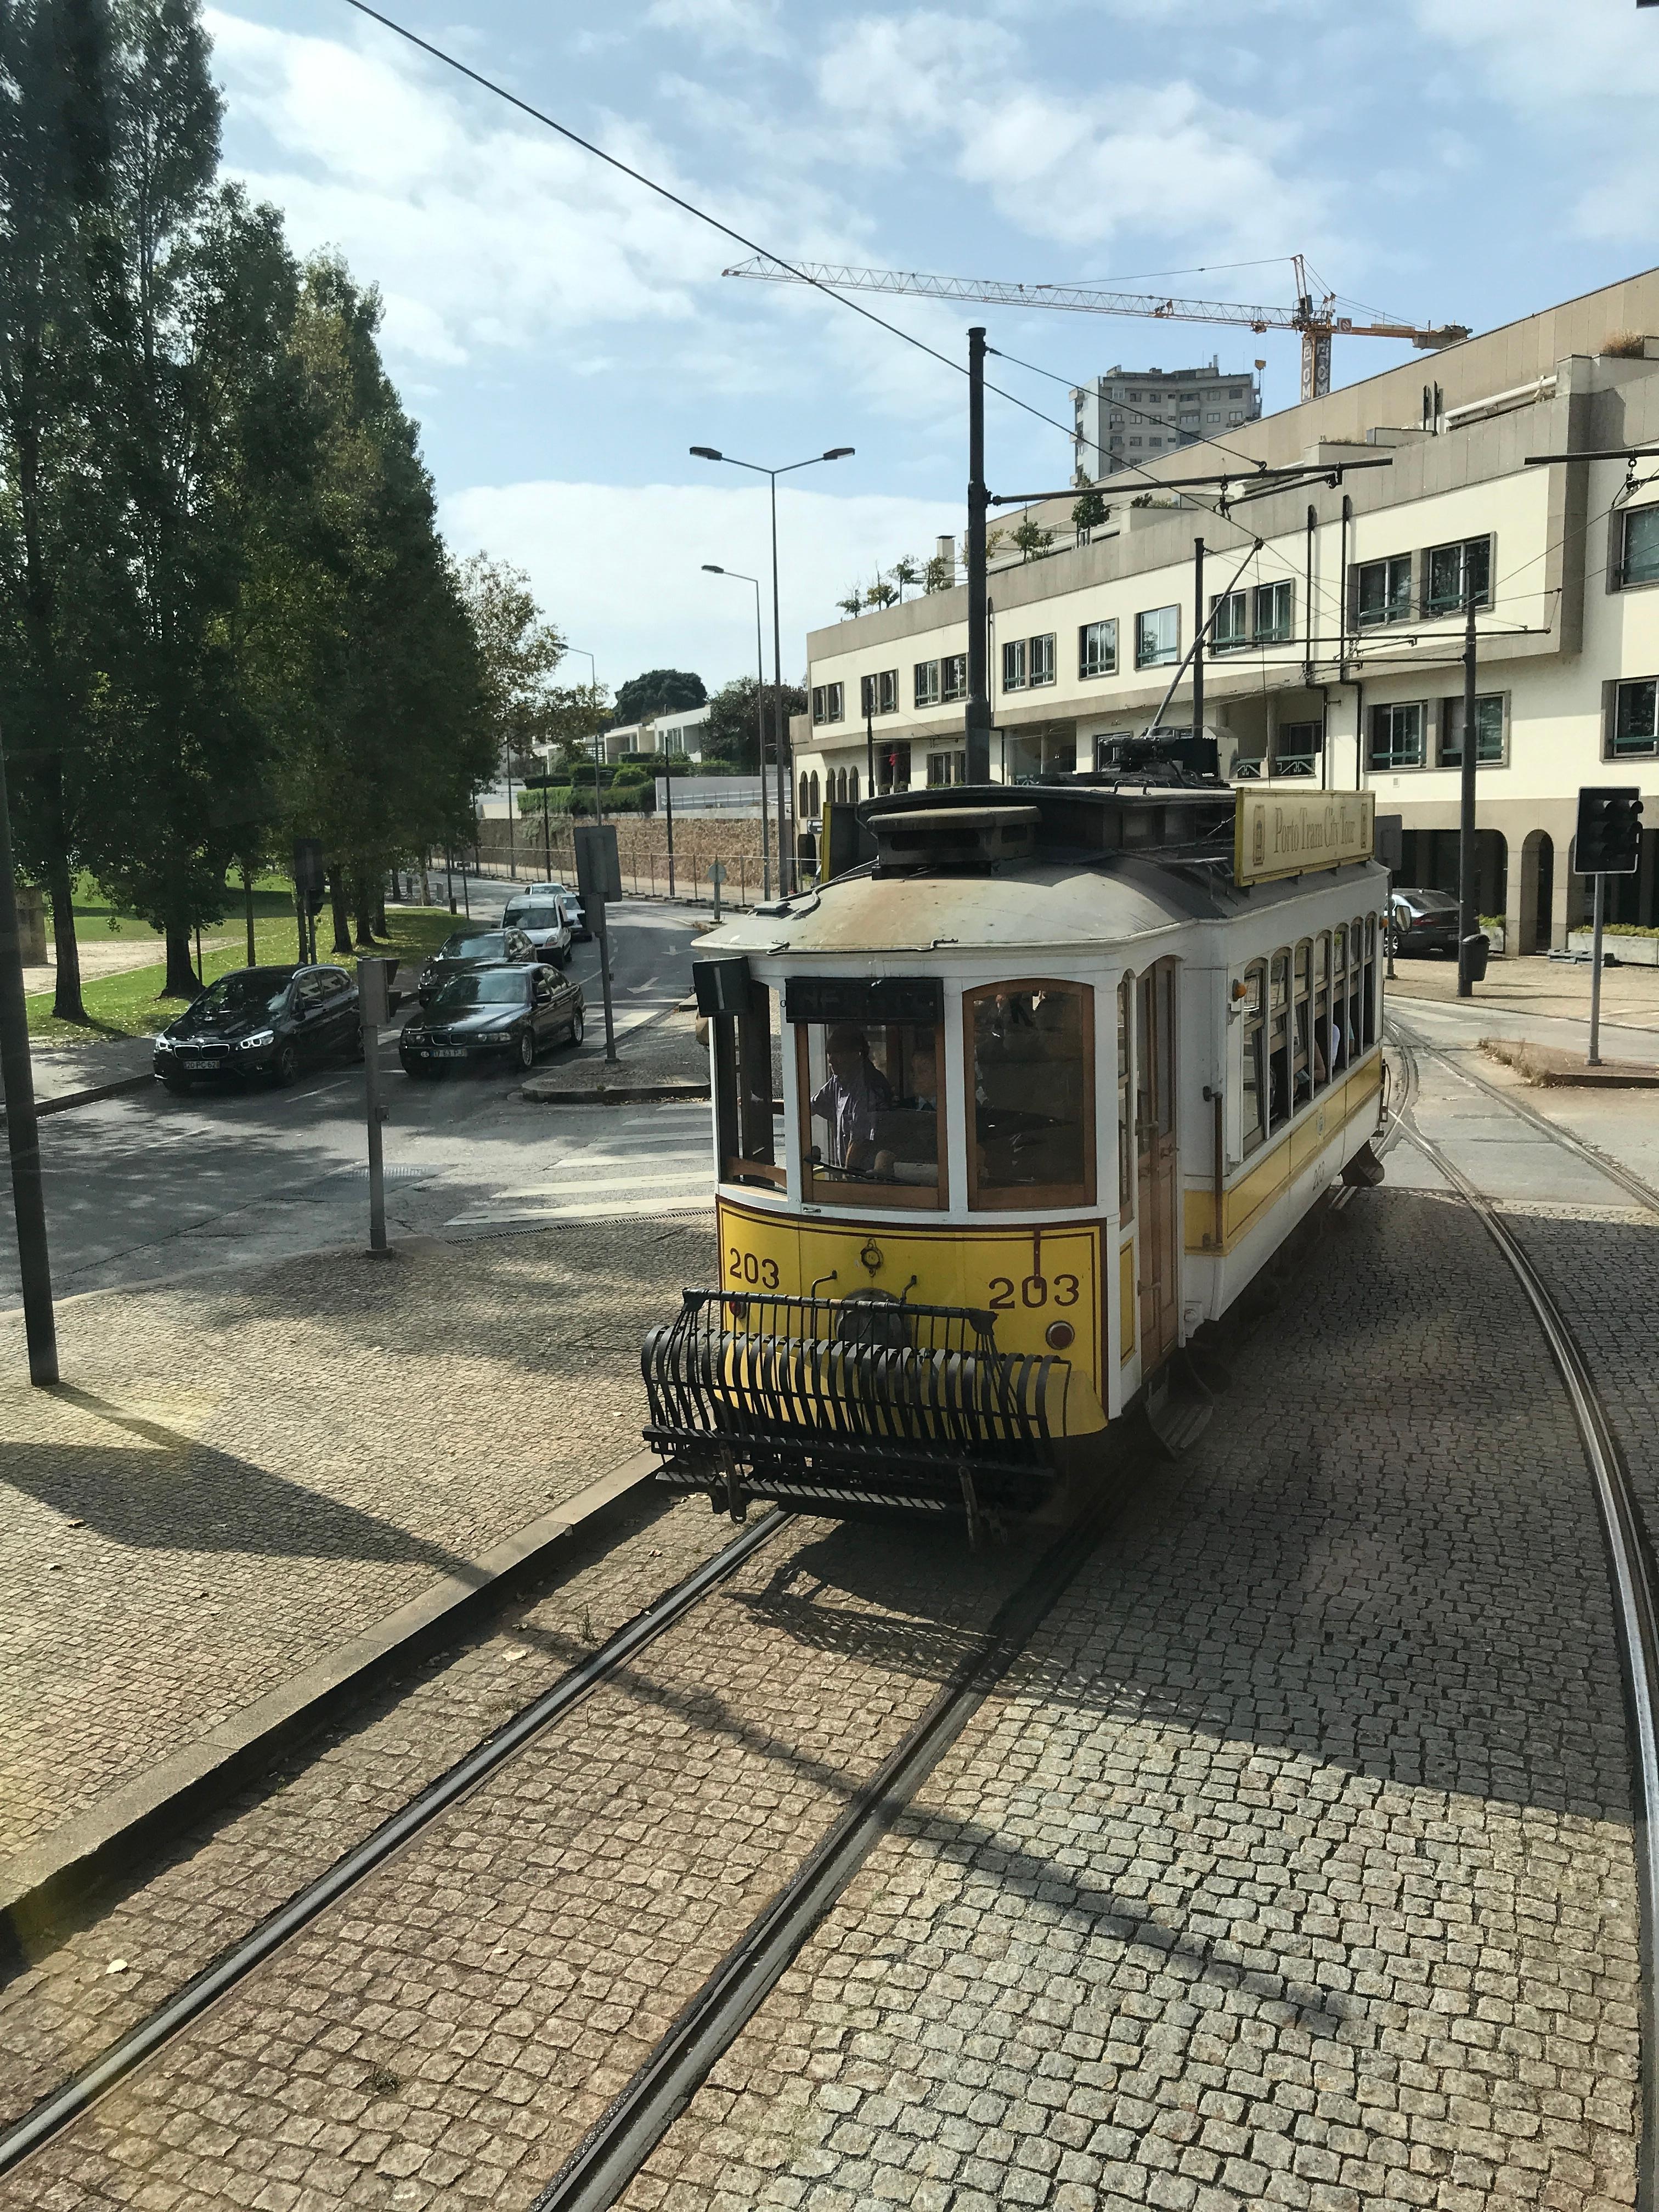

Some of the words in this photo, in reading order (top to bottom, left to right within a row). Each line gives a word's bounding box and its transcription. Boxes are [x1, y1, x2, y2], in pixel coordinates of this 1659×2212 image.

[1274, 807, 1299, 853] Porto
[1300, 807, 1323, 849] Tram
[1324, 806, 1339, 848] City
[1340, 806, 1356, 844] Tour
[730, 1248, 780, 1290] 203
[988, 1274, 1080, 1310] 203
